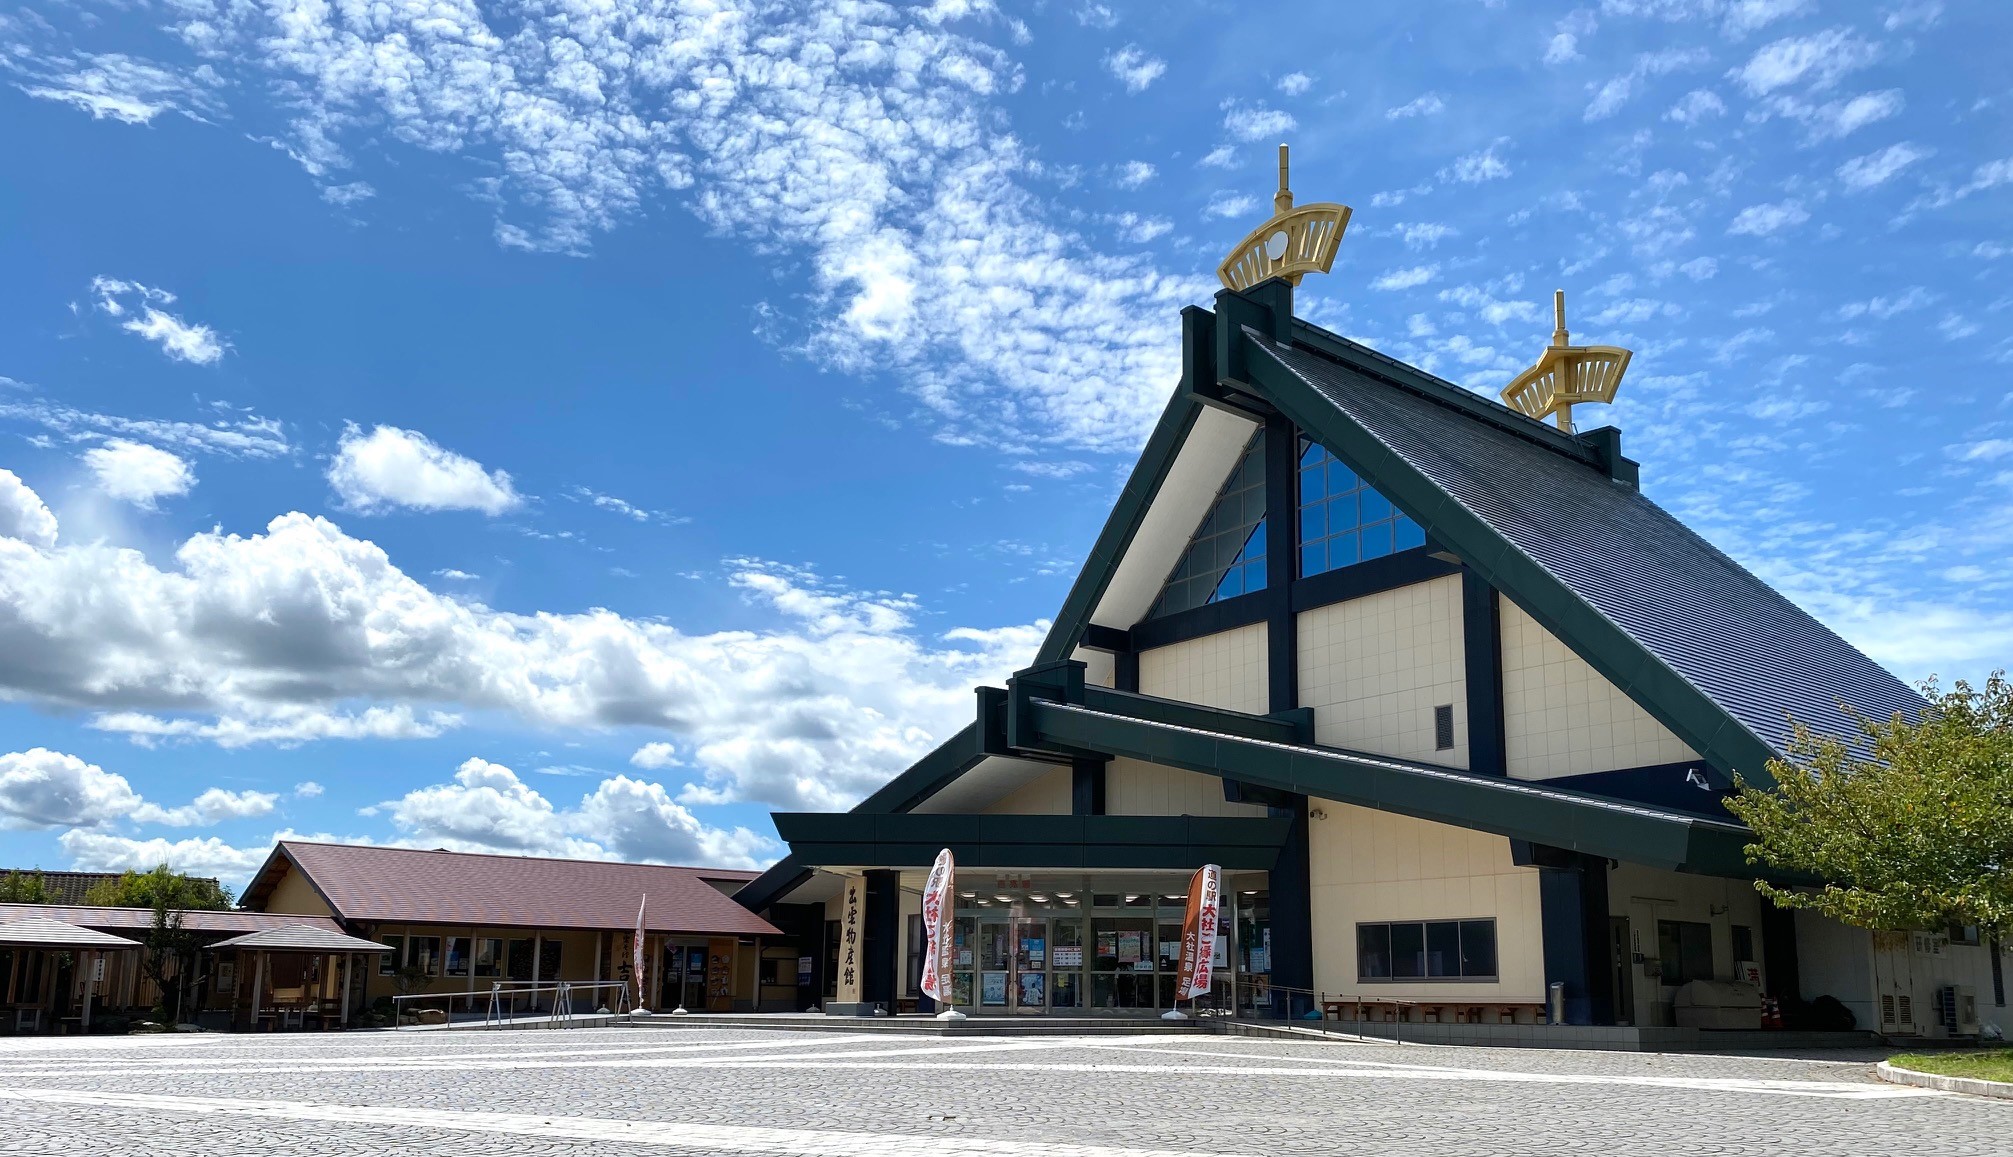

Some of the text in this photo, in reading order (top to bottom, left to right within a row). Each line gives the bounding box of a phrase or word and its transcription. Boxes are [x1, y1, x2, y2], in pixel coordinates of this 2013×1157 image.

[843, 886, 858, 986] 出雲物産館
[1183, 931, 1195, 972] 大社温泉
[1194, 869, 1217, 990] 道の駅 大社ご縁広場
